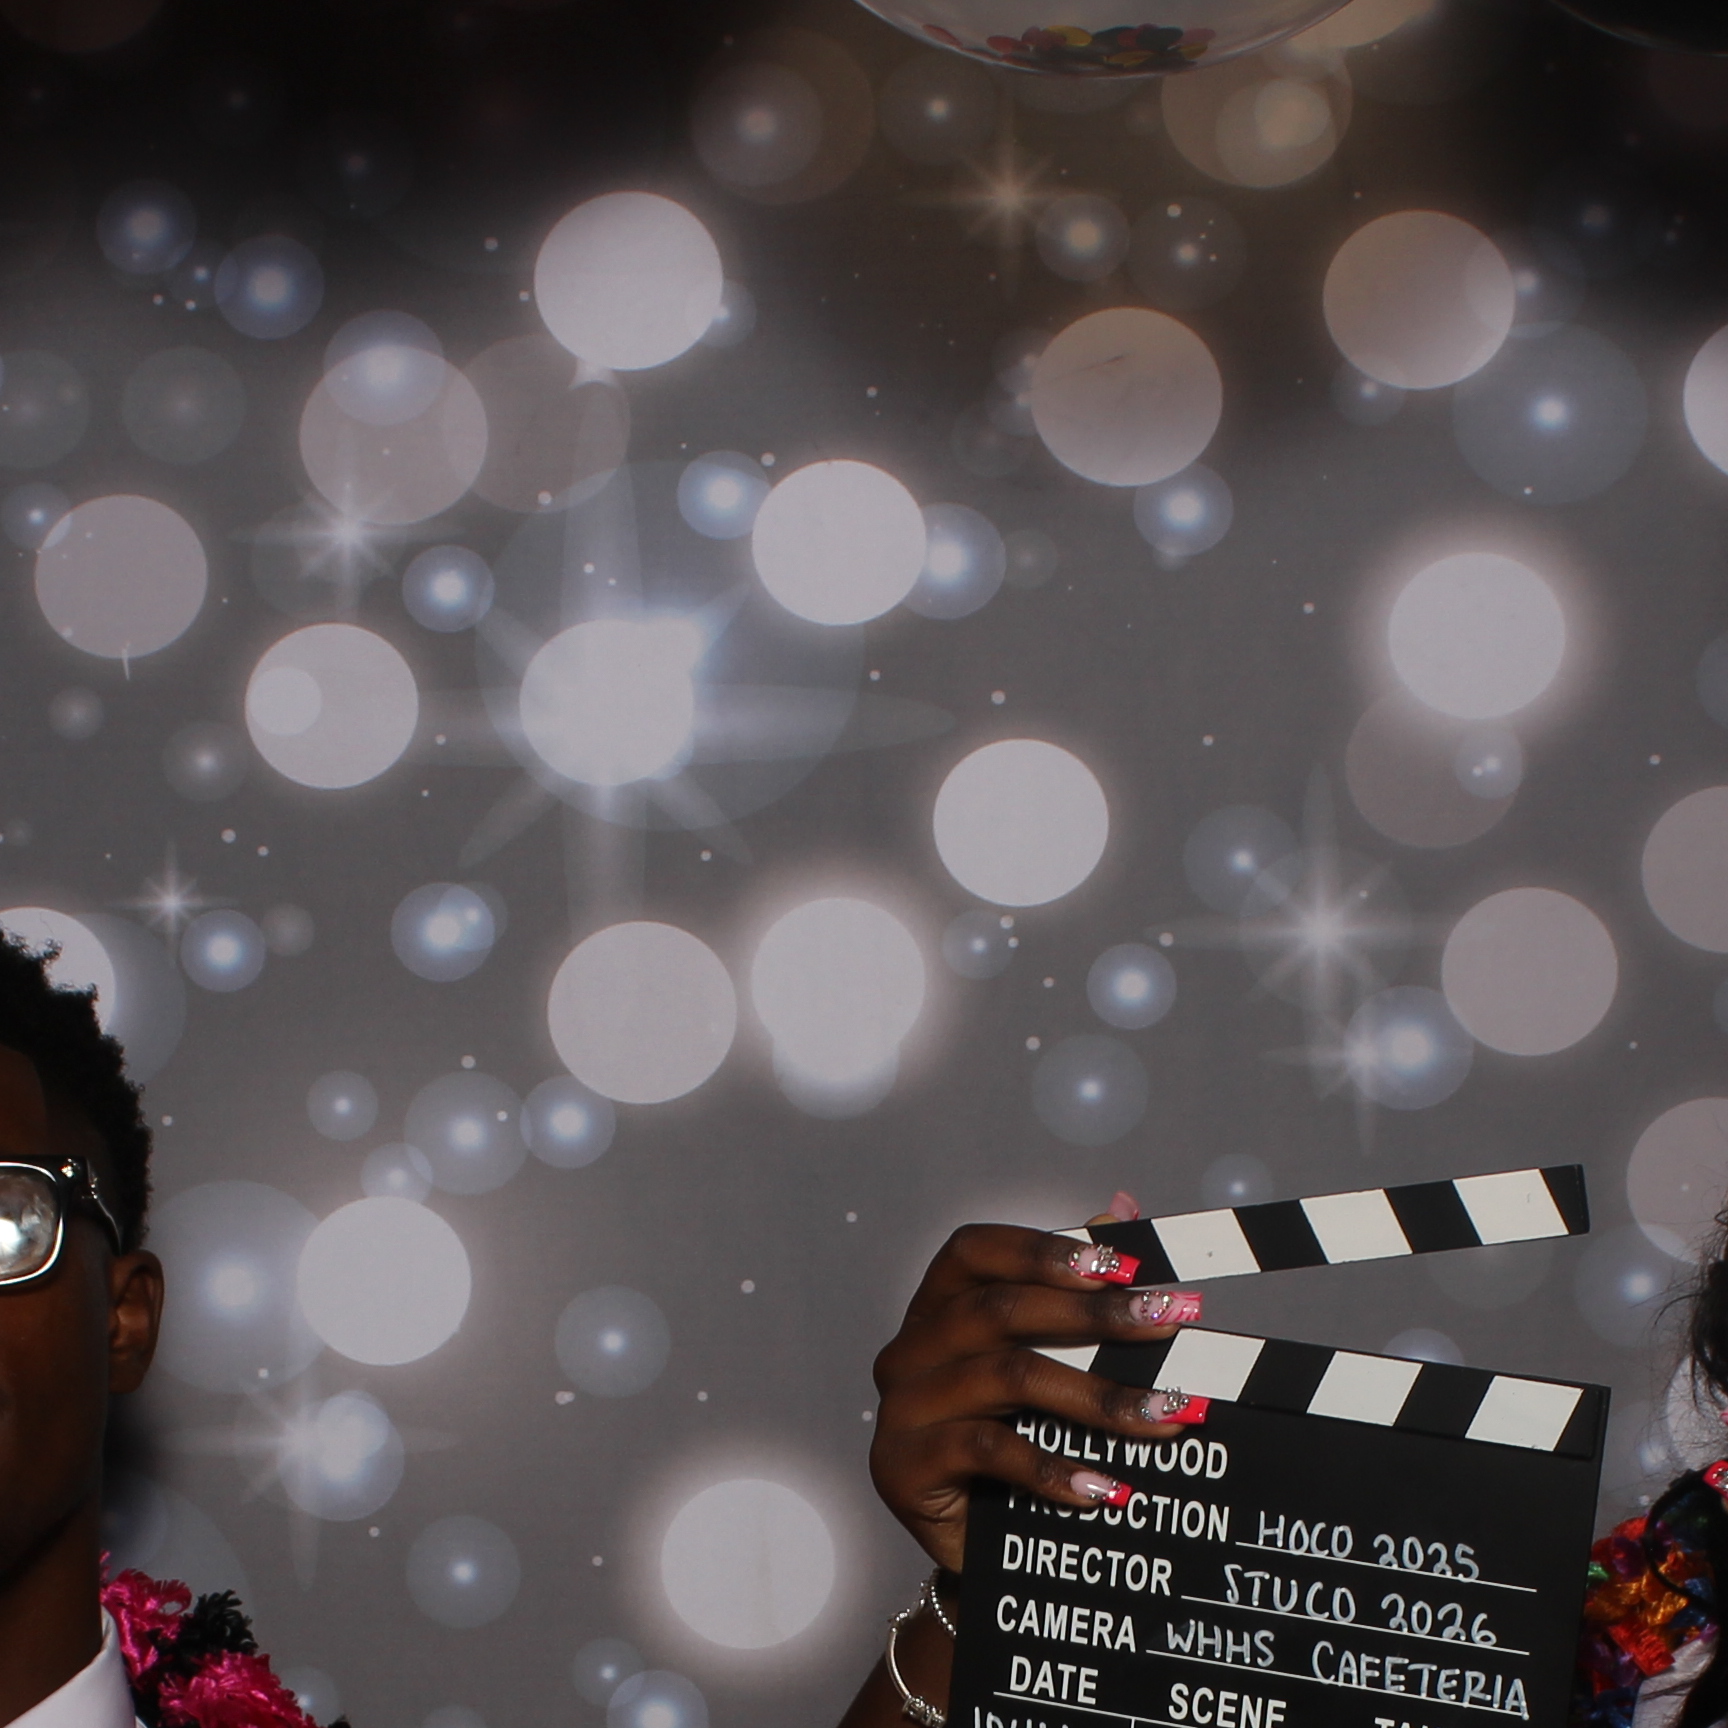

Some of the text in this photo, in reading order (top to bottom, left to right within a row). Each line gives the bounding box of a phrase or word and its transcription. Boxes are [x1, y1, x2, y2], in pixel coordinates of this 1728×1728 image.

[1007, 1483, 1230, 1543] UCTION
[1003, 1534, 1172, 1596] DIRECTOR
[1258, 1511, 1479, 1581] HOCO 2025
[997, 1595, 1135, 1653] CAMERA
[1224, 1564, 1496, 1646] STUCO 2026
[1010, 1656, 1098, 1704] DATE
[1167, 1619, 1529, 1720] WHHS CAFETERIA
